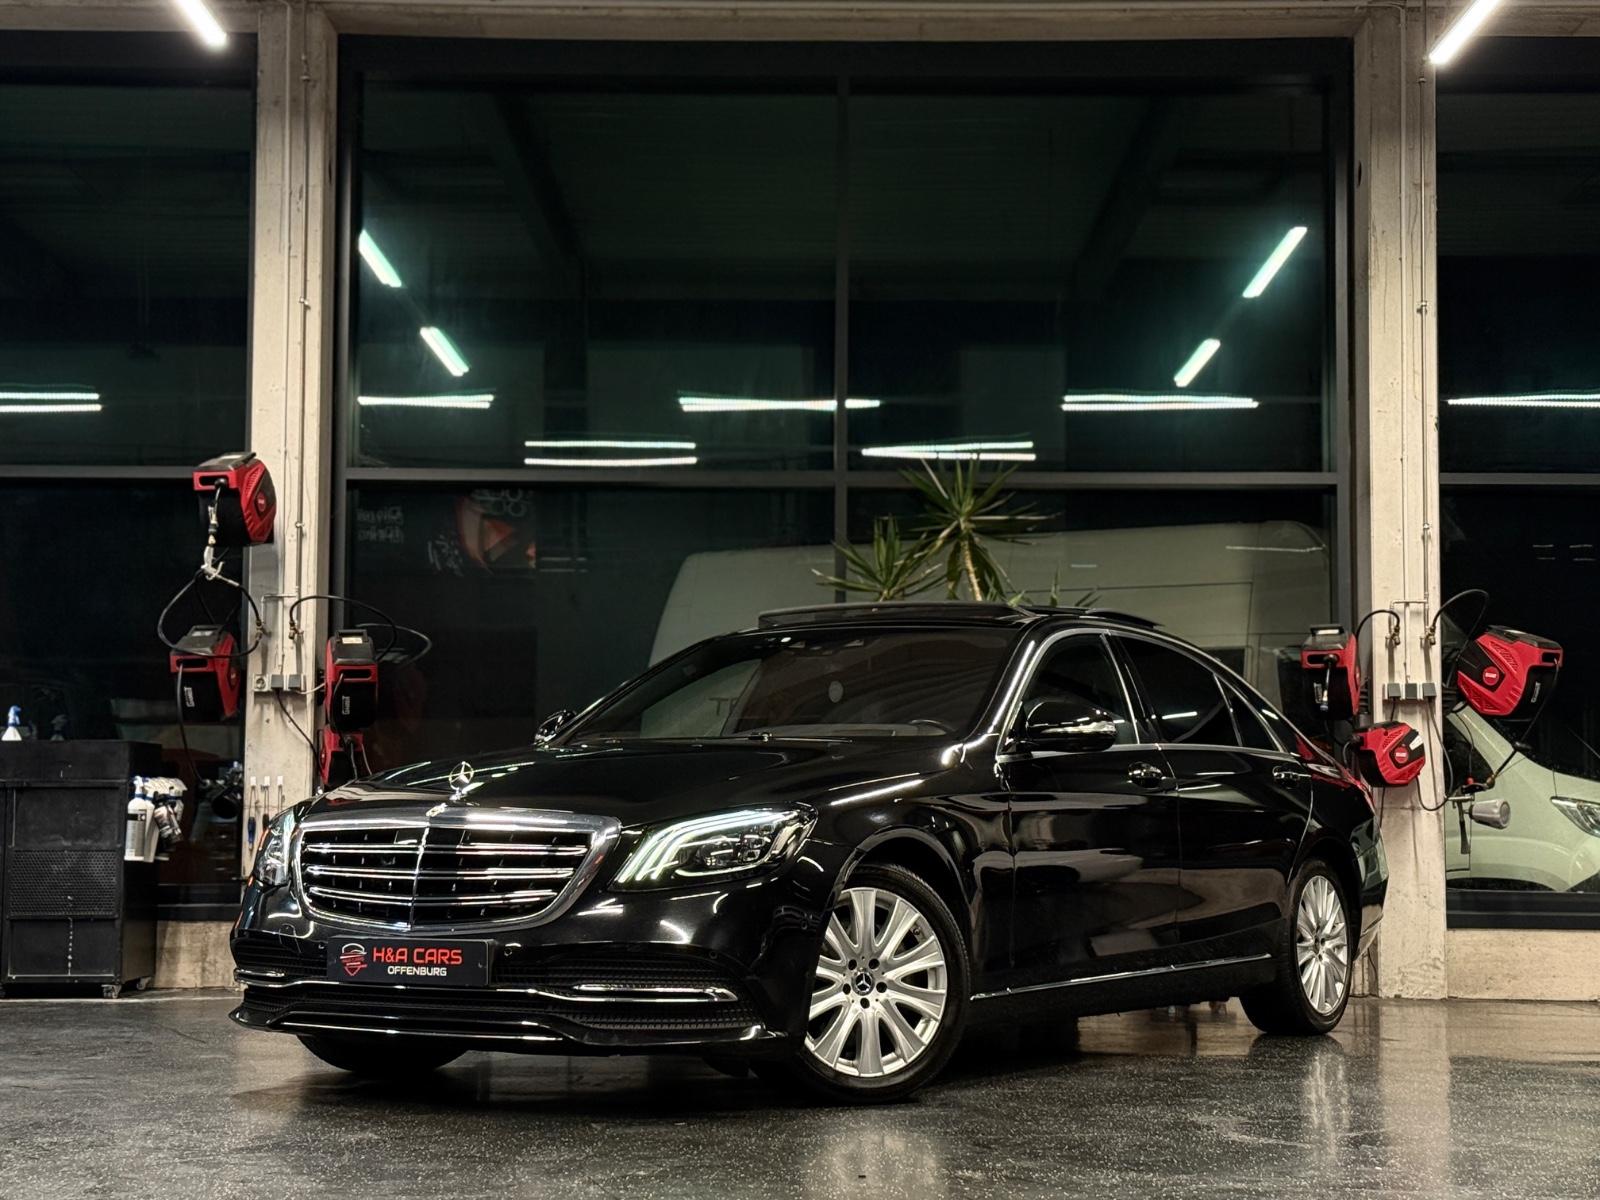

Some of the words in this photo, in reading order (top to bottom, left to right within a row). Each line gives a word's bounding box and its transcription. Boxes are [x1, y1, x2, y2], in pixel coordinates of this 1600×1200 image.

[373, 947, 408, 963] H&A
[413, 947, 463, 965] CARS
[387, 965, 447, 976] OFFENBURG
